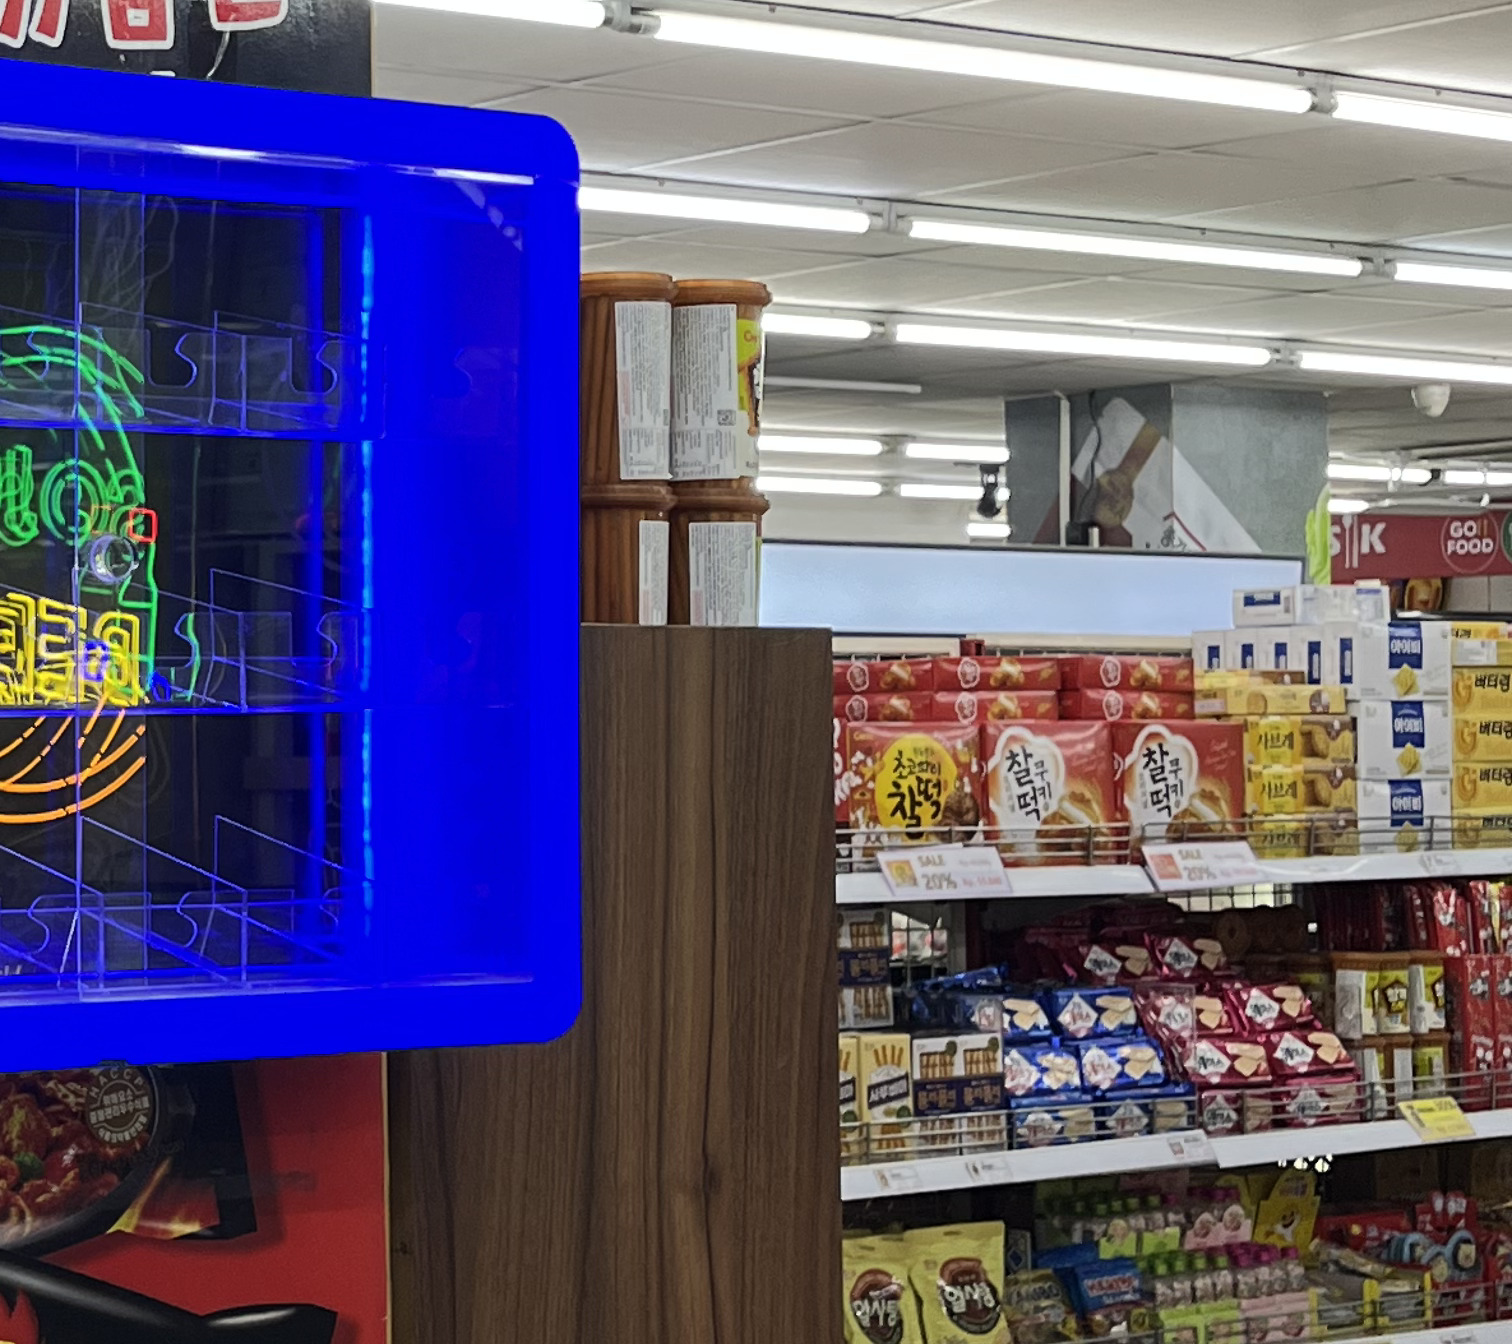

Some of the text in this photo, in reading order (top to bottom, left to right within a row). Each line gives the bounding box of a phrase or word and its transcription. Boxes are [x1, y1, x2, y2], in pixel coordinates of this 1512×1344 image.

[1450, 520, 1477, 538] GO
[1447, 537, 1494, 555] FOOD
[1257, 731, 1294, 750] 사브레
[1005, 745, 1041, 821] 찰떡
[1143, 743, 1172, 818] 찰떡
[1260, 781, 1297, 800] 사브레
[887, 776, 942, 840] 찰떡
[921, 873, 957, 890] 20%
